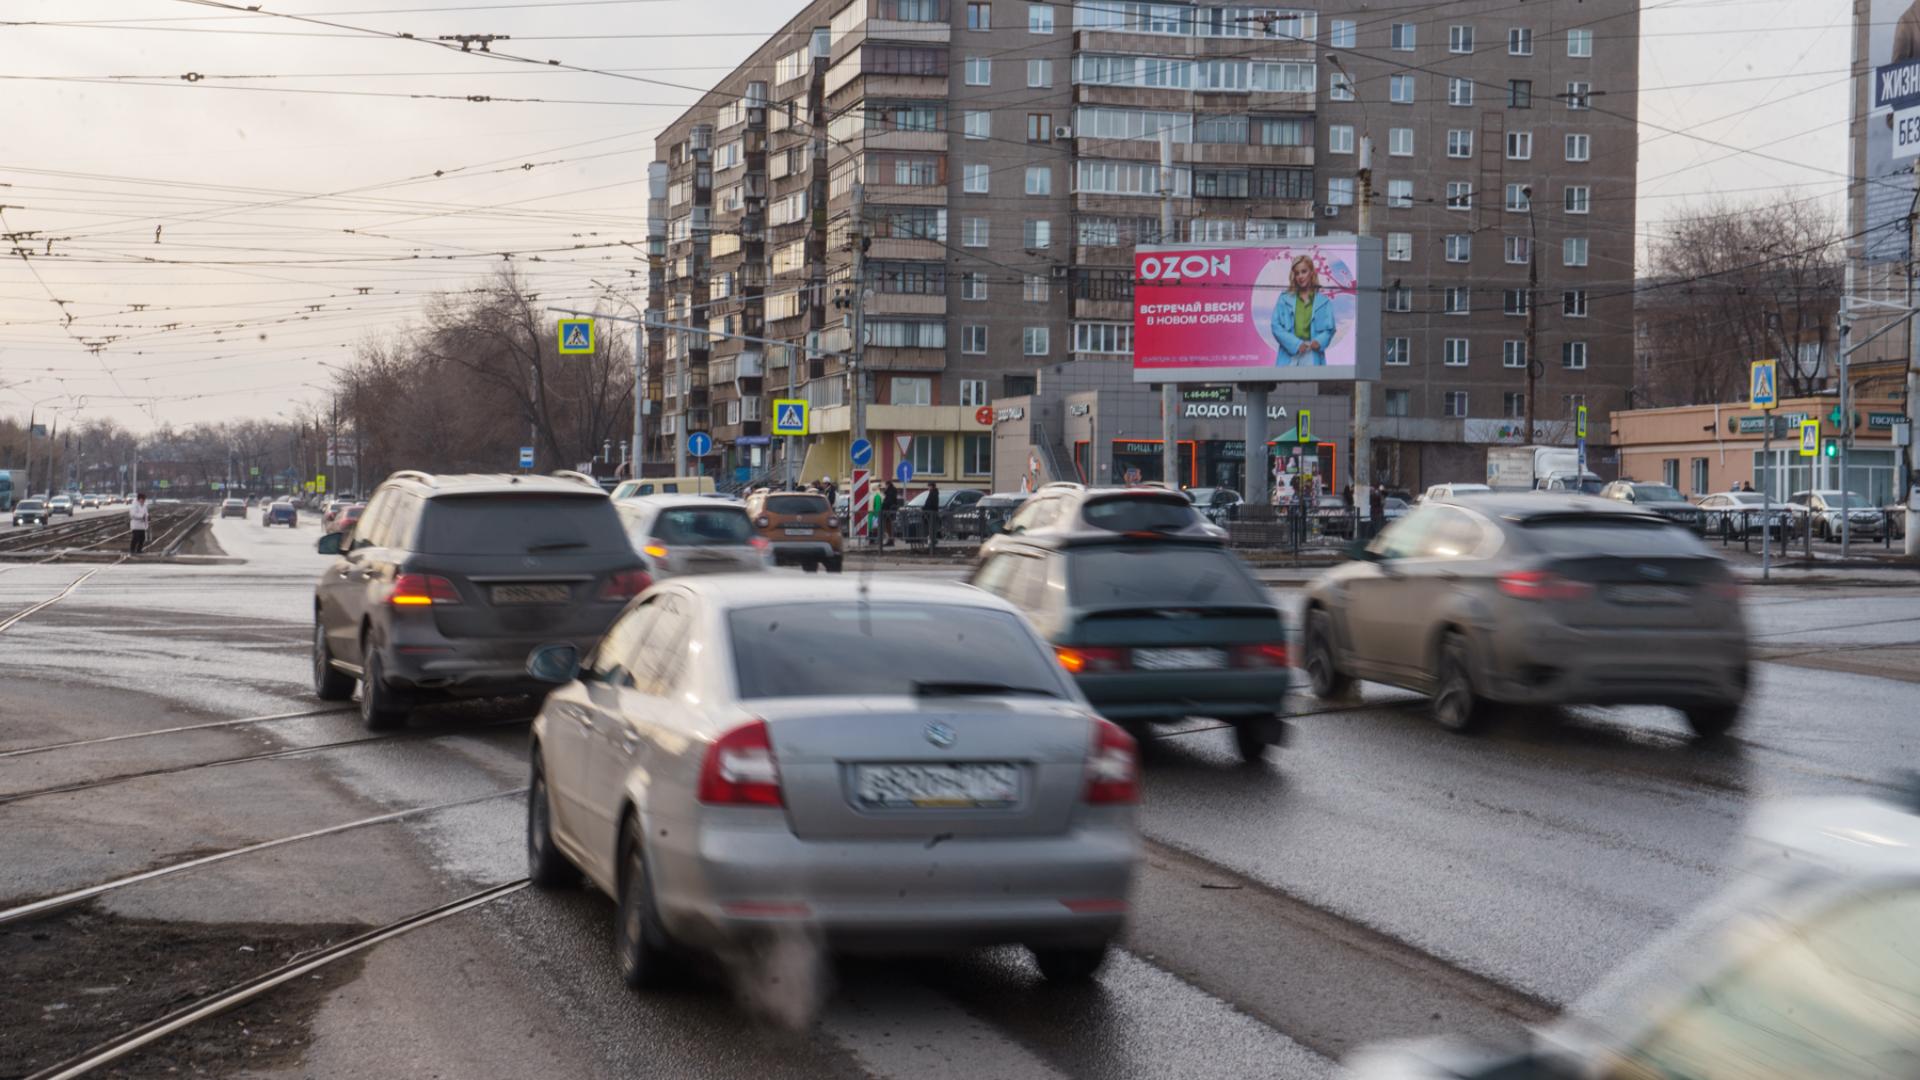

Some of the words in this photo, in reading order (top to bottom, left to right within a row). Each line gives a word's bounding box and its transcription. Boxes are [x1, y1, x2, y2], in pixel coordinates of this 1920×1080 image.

[1141, 255, 1231, 280] OZON
[1140, 301, 1202, 314] ВСТРЕЧАЙ
[1204, 302, 1245, 312] ВЕСНУ
[1147, 315, 1154, 326] В
[1156, 315, 1197, 325] НОВОМ
[1199, 313, 1244, 324] ОБРАЗЕ
[1185, 404, 1230, 417] ДОДО
[1232, 405, 1287, 419] ПЦА
